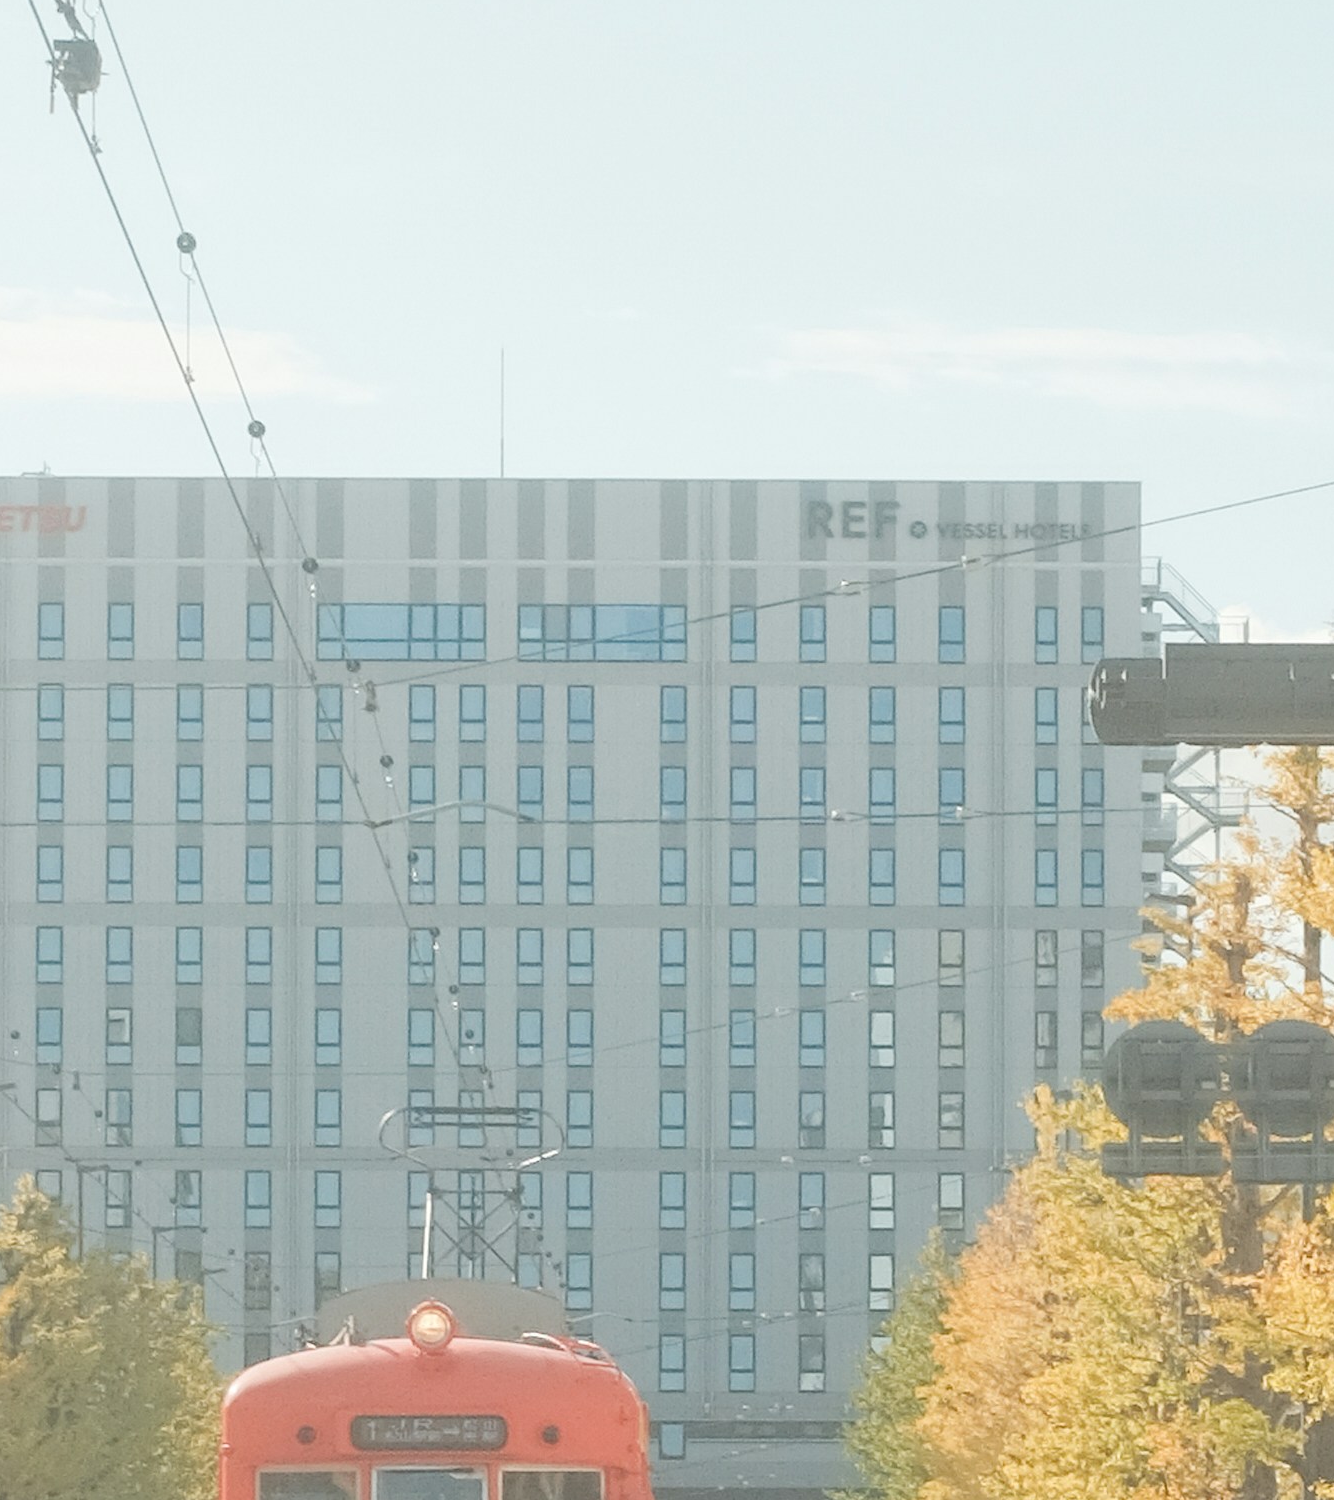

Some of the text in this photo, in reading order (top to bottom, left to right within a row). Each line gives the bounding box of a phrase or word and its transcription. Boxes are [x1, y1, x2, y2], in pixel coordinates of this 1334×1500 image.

[807, 501, 901, 539] REF
[937, 523, 1092, 541] VESSEL HOTELS
